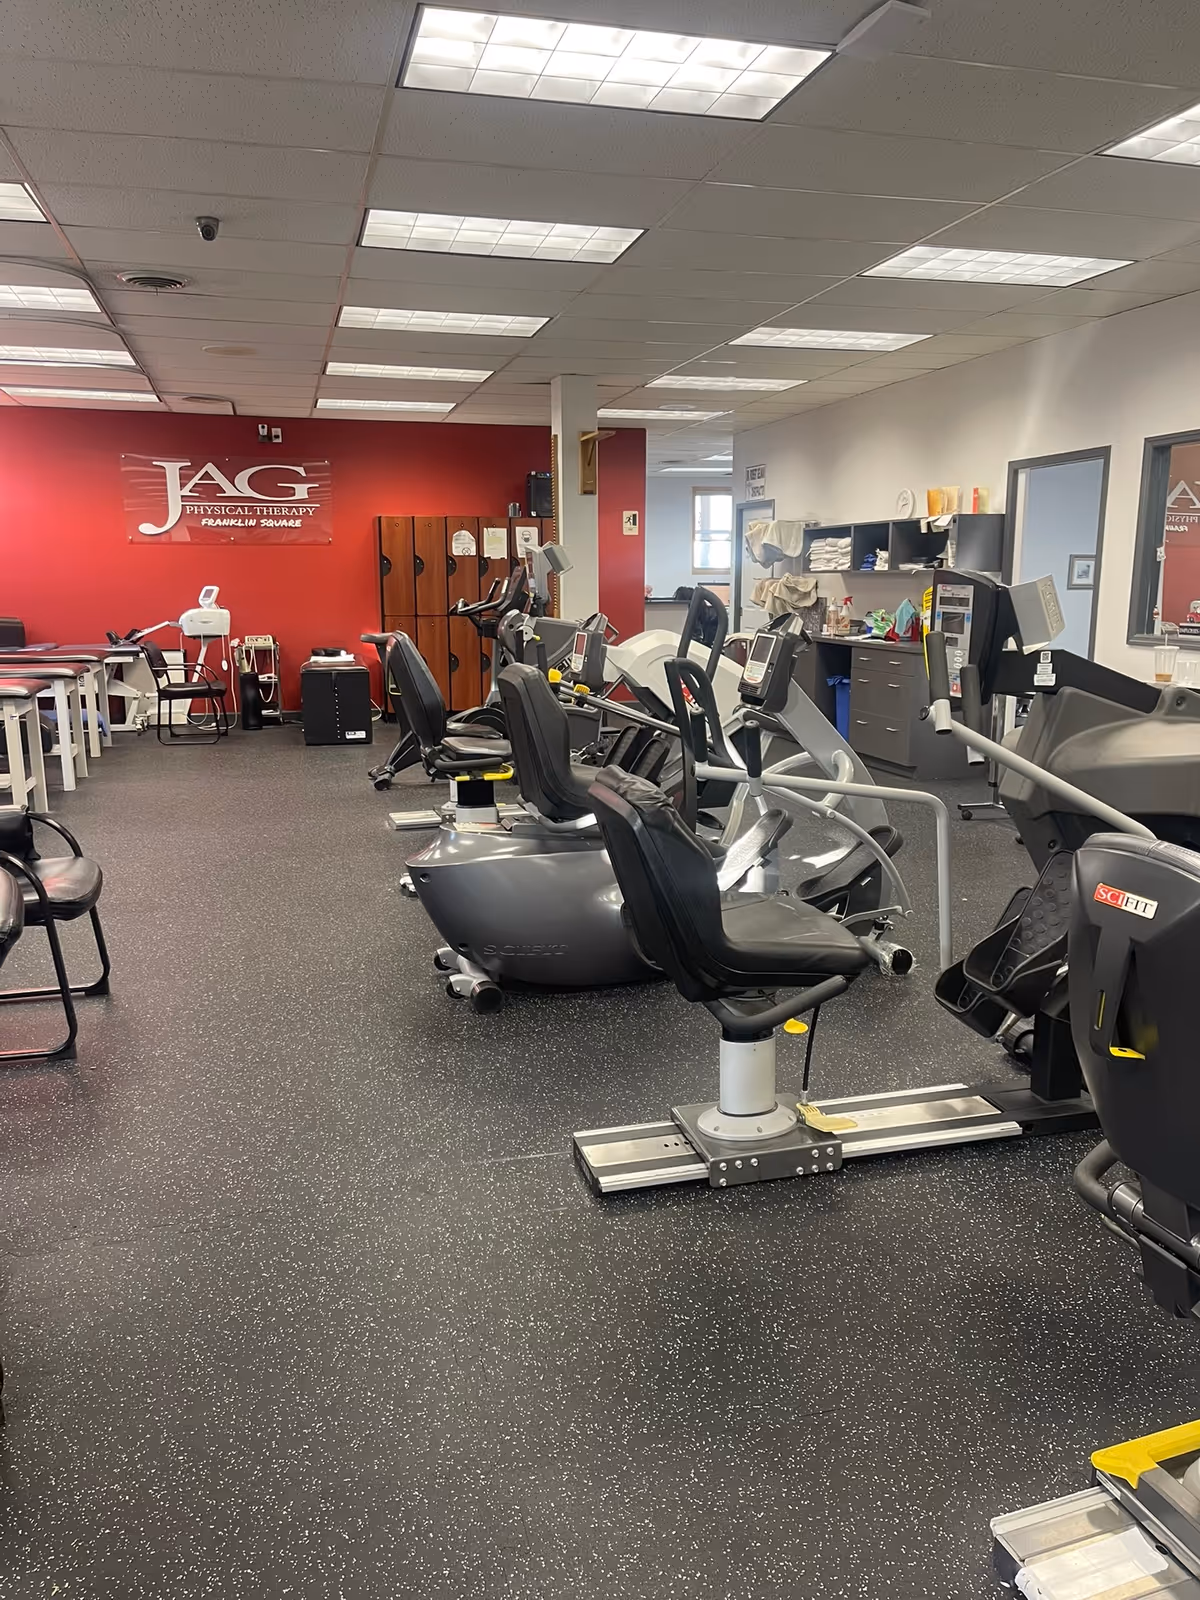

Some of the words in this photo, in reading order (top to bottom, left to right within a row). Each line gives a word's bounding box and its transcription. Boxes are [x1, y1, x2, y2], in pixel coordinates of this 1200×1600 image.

[138, 461, 320, 535] JAG
[185, 505, 252, 515] PHYSICAL
[255, 506, 316, 516] THERAPY
[201, 518, 257, 527] FRANKLIN
[260, 518, 302, 528] SQUARE
[1097, 887, 1154, 914] SCIFIT
